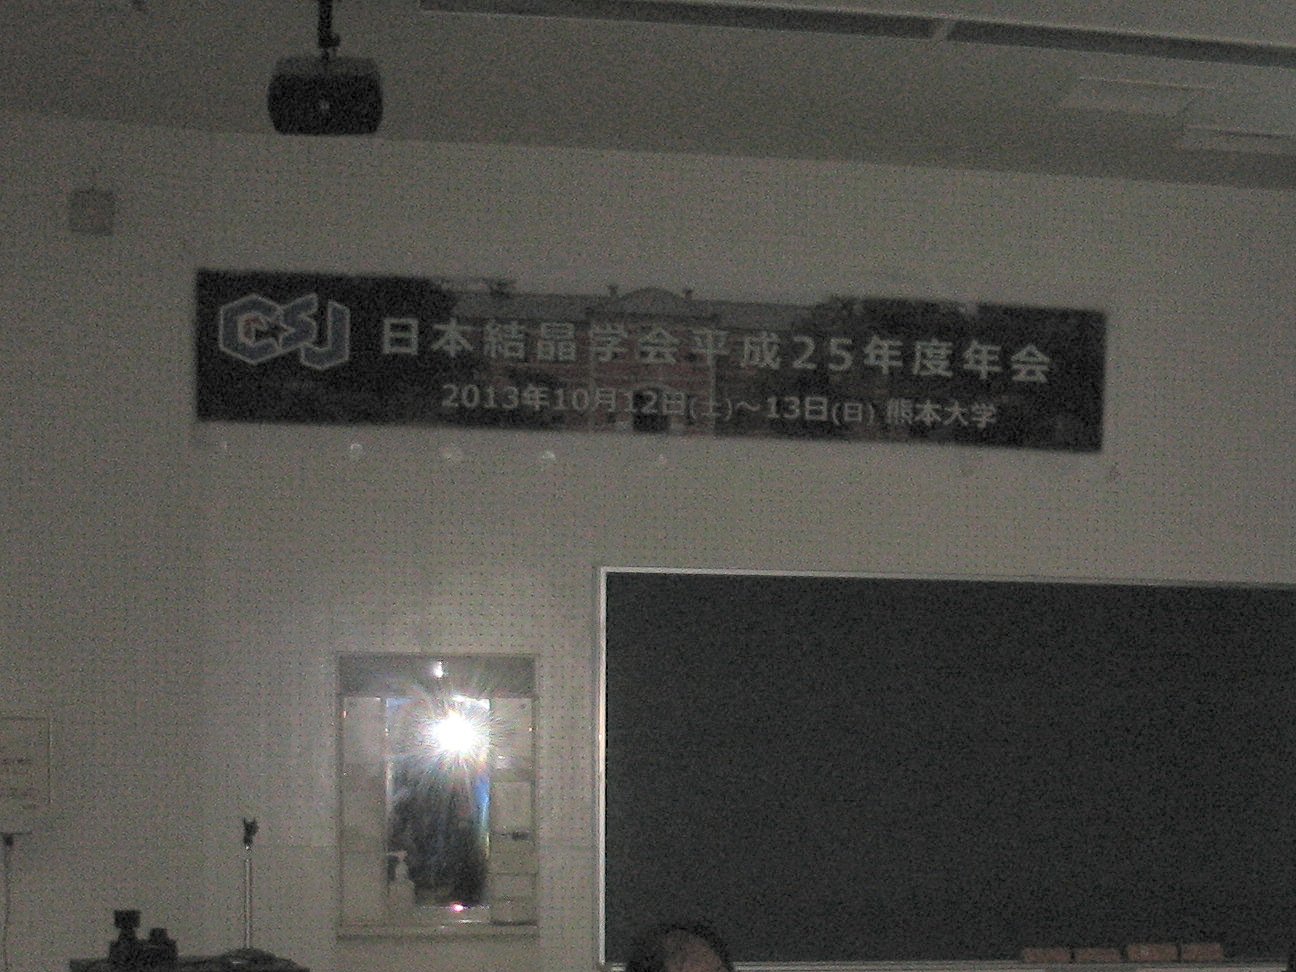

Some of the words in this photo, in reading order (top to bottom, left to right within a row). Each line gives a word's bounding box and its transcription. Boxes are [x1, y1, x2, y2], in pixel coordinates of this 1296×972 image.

[219, 293, 351, 370] CSJ
[382, 317, 1051, 384] 日本結晶学会平成25年度年会
[885, 401, 997, 428] 熊本大学
